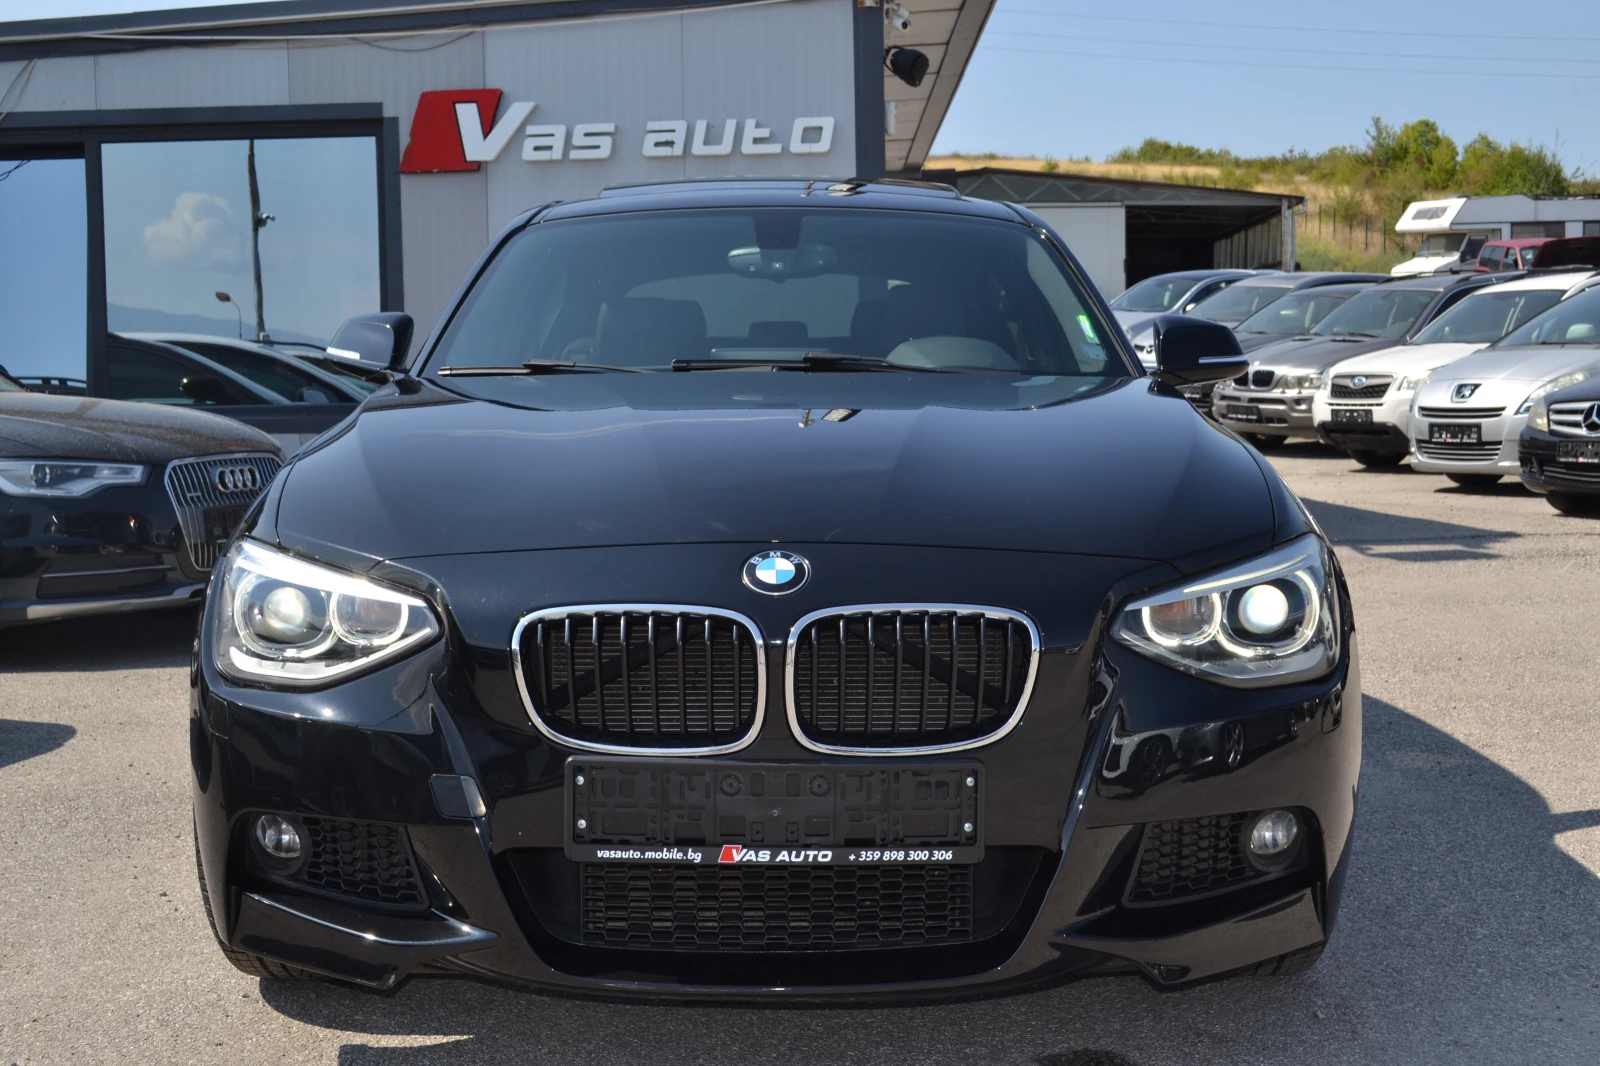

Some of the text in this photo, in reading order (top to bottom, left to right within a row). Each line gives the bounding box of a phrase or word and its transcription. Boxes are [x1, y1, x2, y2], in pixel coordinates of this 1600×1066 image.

[454, 101, 835, 162] Vas auto
[750, 552, 802, 565] BMW
[597, 848, 702, 863] vasauto.mobile.bg
[731, 848, 833, 862] VAS AUTO
[882, 850, 905, 861] 898
[906, 850, 930, 861] 300
[930, 850, 953, 861] 306
